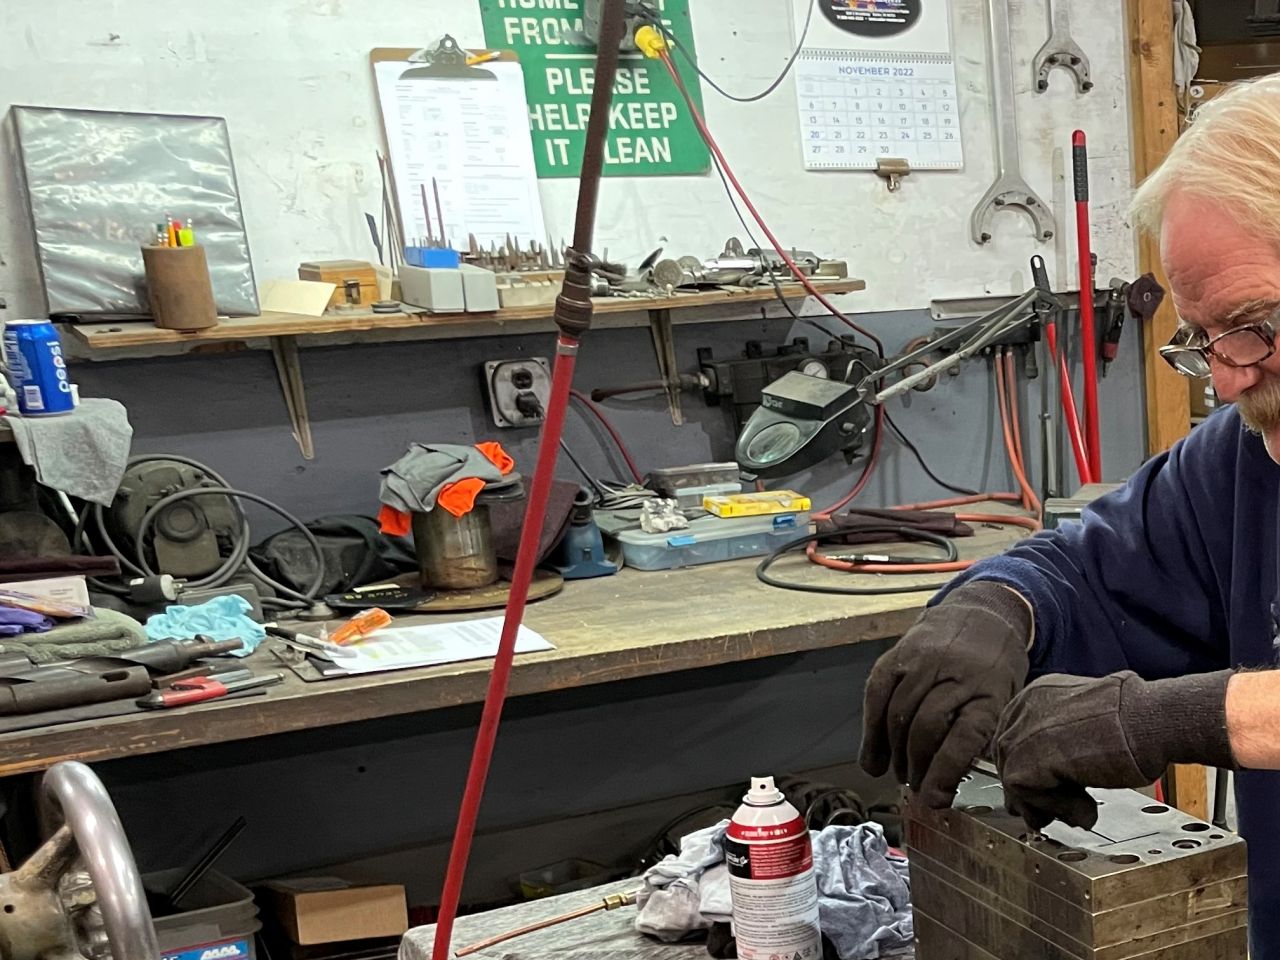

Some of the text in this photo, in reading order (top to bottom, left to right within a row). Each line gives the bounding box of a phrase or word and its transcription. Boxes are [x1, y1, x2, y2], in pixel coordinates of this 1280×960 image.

[545, 67, 651, 95] PLESE
[838, 66, 914, 77] NOVEMBER 2022
[608, 102, 678, 130] KEEP
[545, 137, 673, 166] IT LEAN
[46, 340, 71, 393] pepsi
